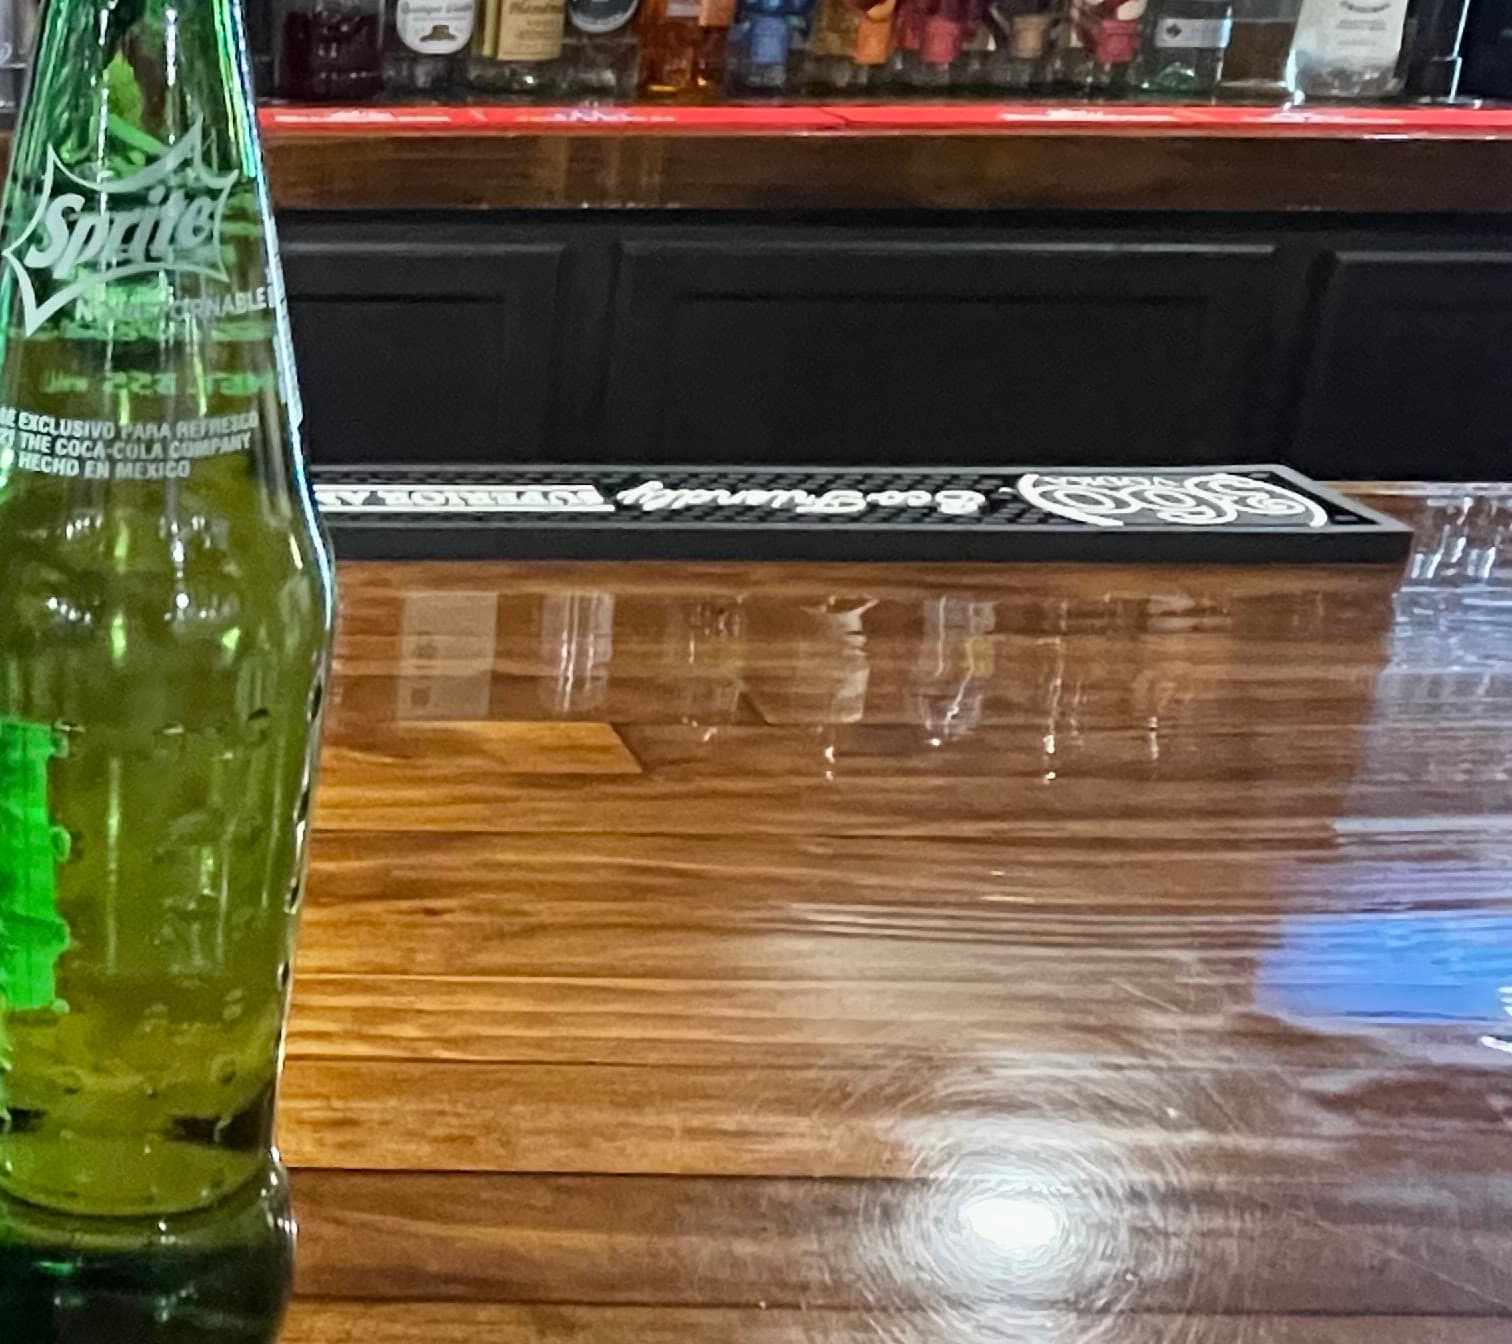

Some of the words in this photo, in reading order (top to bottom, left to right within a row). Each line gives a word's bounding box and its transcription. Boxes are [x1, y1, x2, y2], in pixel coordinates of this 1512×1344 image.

[25, 185, 216, 280] Sprite
[18, 412, 115, 439] EXCLUSIVO
[121, 420, 171, 441] PARA
[176, 409, 260, 438] REFRESCO
[20, 430, 52, 455] THE
[55, 437, 164, 460] COCA-COLA
[168, 432, 252, 458] COMPANY
[18, 451, 80, 476] HECHO
[84, 460, 110, 479] EN
[115, 460, 191, 479] MEXICO
